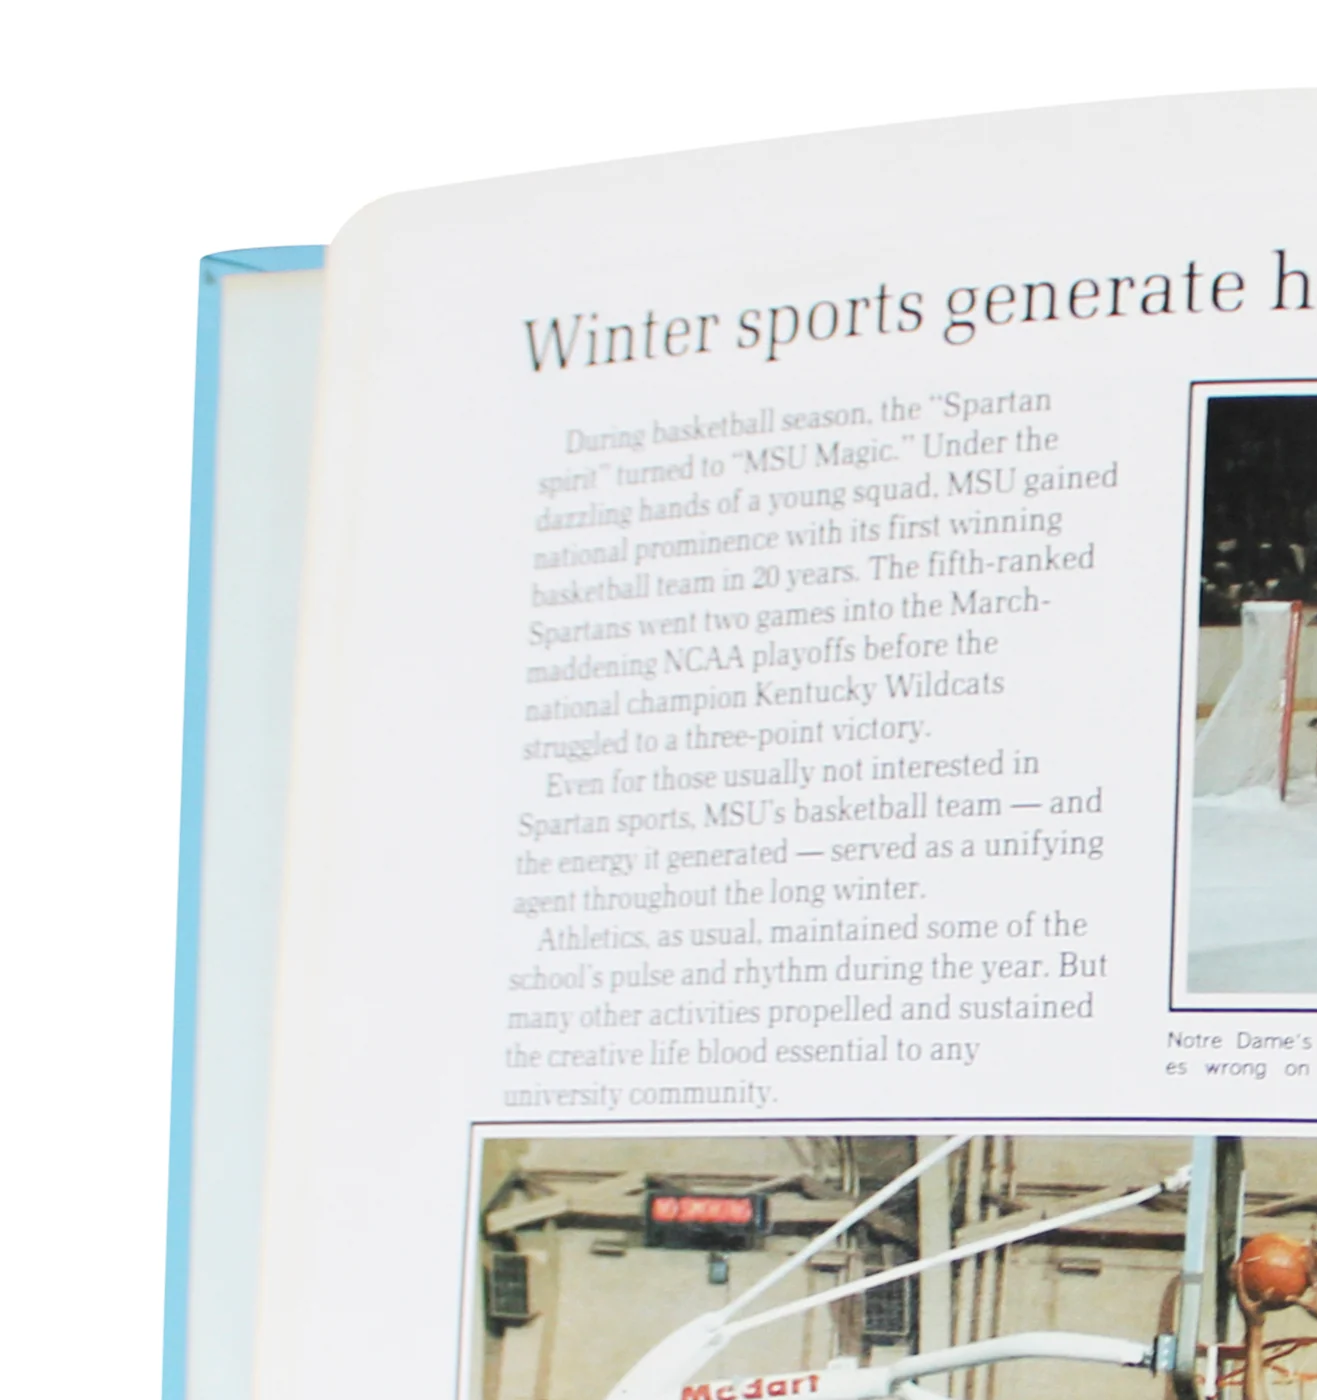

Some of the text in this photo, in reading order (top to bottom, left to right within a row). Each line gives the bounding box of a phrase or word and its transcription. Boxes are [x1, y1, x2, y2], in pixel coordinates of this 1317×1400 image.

[523, 311, 720, 373] Winter
[736, 282, 924, 363] sports
[942, 259, 1246, 346] generate
[563, 395, 923, 455] During basketball the
[615, 424, 1060, 486] turned Under the
[533, 461, 1119, 533] dazzling hands young MSU gained
[633, 508, 1063, 566] prominence with first winning
[530, 542, 1095, 608] basketball team 20 years. The fifth-ranked
[527, 585, 1052, 650] Spartans went two games into the March-
[524, 628, 999, 685] maddening NCAA playoffs before the
[523, 669, 1006, 723] national champion Kentucky Wildcats
[521, 717, 932, 762] struggled three-point victory.
[610, 749, 1040, 794] for those usually not interested in
[517, 785, 1103, 841] Spartan sports, basketball team and
[665, 828, 1104, 874] generated served unifying
[581, 876, 927, 914] throughout the long winter.
[768, 909, 1089, 944] maintained some of the
[608, 951, 1107, 994] pulse and rhythm during the year. But
[577, 991, 1094, 1029] other activities propelled and sustained
[648, 1035, 981, 1067] life blood essential any
[1167, 1031, 1223, 1050] Notre
[1236, 1030, 1313, 1051] Dame's
[1164, 1060, 1188, 1076] es
[1203, 1061, 1268, 1081] wrong
[1283, 1062, 1311, 1078] on
[502, 1080, 779, 1111] university community.
